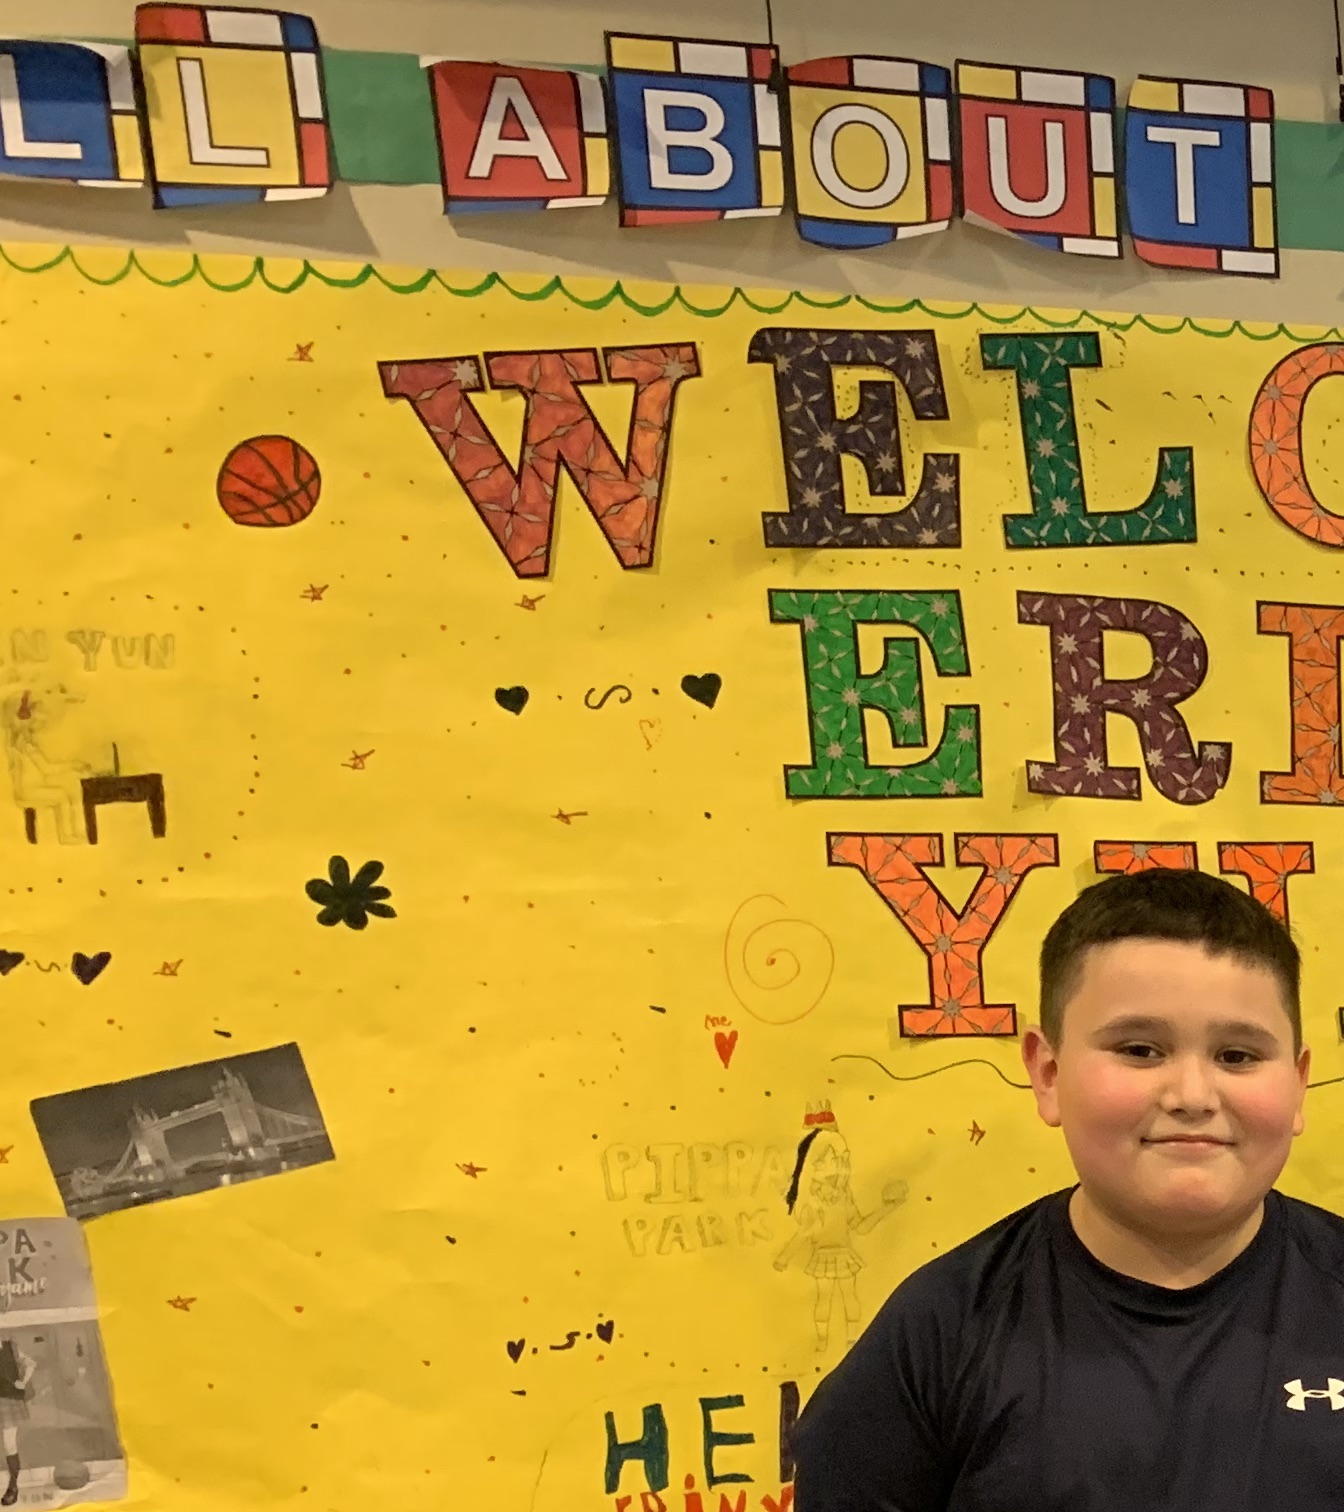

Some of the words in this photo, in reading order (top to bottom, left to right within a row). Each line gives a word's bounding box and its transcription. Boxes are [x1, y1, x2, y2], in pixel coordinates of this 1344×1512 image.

[466, 76, 1221, 226] ABOUT
[601, 1140, 787, 1204] PIPPA
[620, 1207, 775, 1258] PARK
